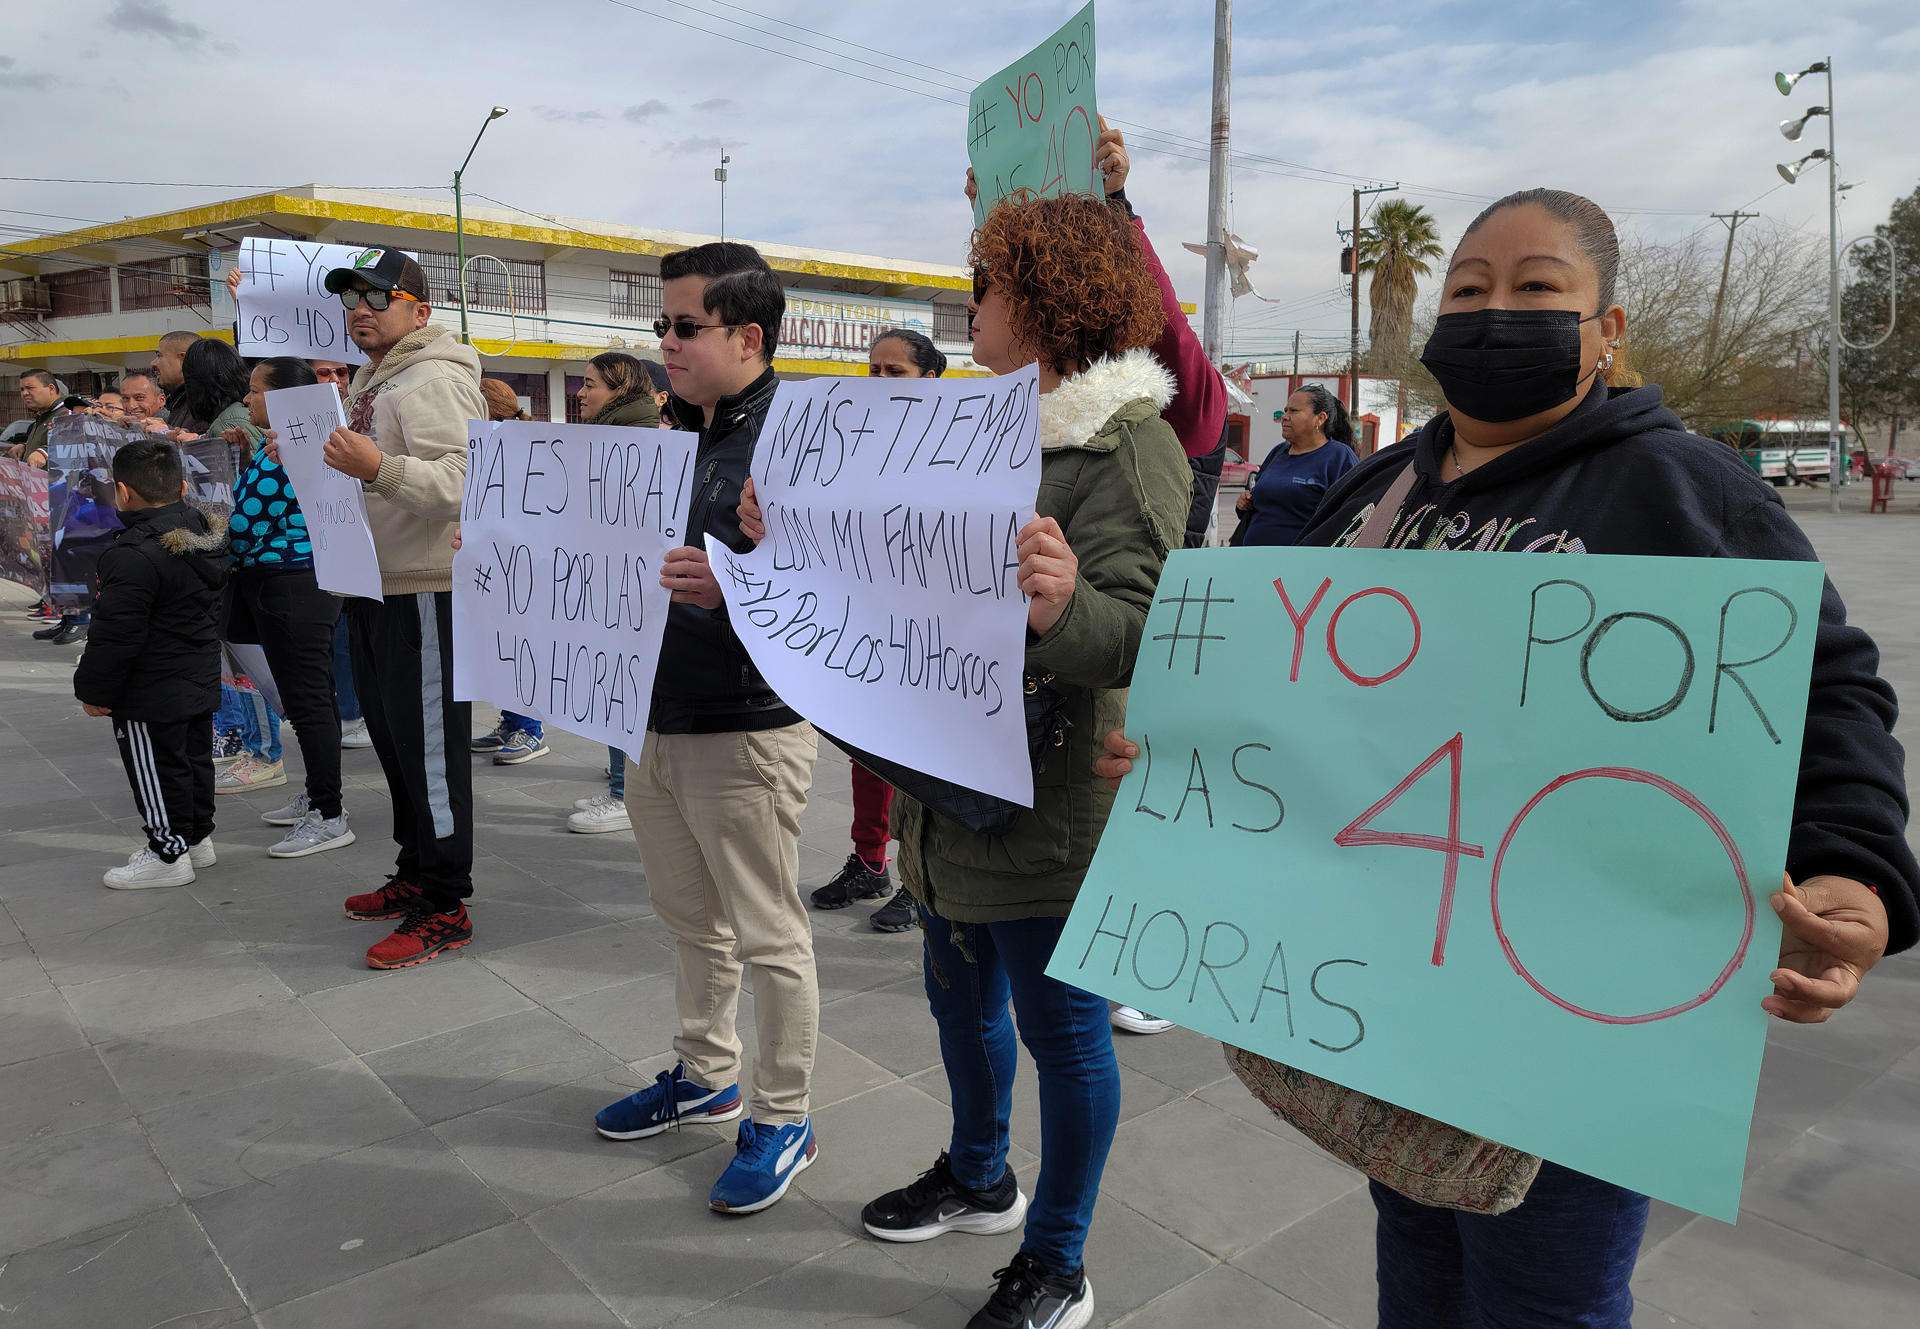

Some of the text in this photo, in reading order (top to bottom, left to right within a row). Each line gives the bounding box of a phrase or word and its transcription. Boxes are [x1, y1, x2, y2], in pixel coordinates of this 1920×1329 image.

[1005, 72, 1044, 129] YO
[1053, 21, 1091, 104] POR
[237, 298, 290, 345] Las
[296, 307, 335, 348] 40
[786, 299, 892, 320] EPARATORIA
[879, 377, 1038, 477] TIEMPO
[522, 438, 569, 516] ES
[588, 441, 690, 538] HORA!
[551, 546, 599, 623] POR
[604, 552, 647, 632] LAS
[766, 501, 1027, 604] CON MI FAMILIA
[497, 630, 640, 735] 40 HORAS
[1273, 576, 1422, 687] YO
[1519, 578, 1799, 745] POR
[1134, 731, 1756, 1026] LAS 40
[1078, 894, 1368, 1054] HORAS
